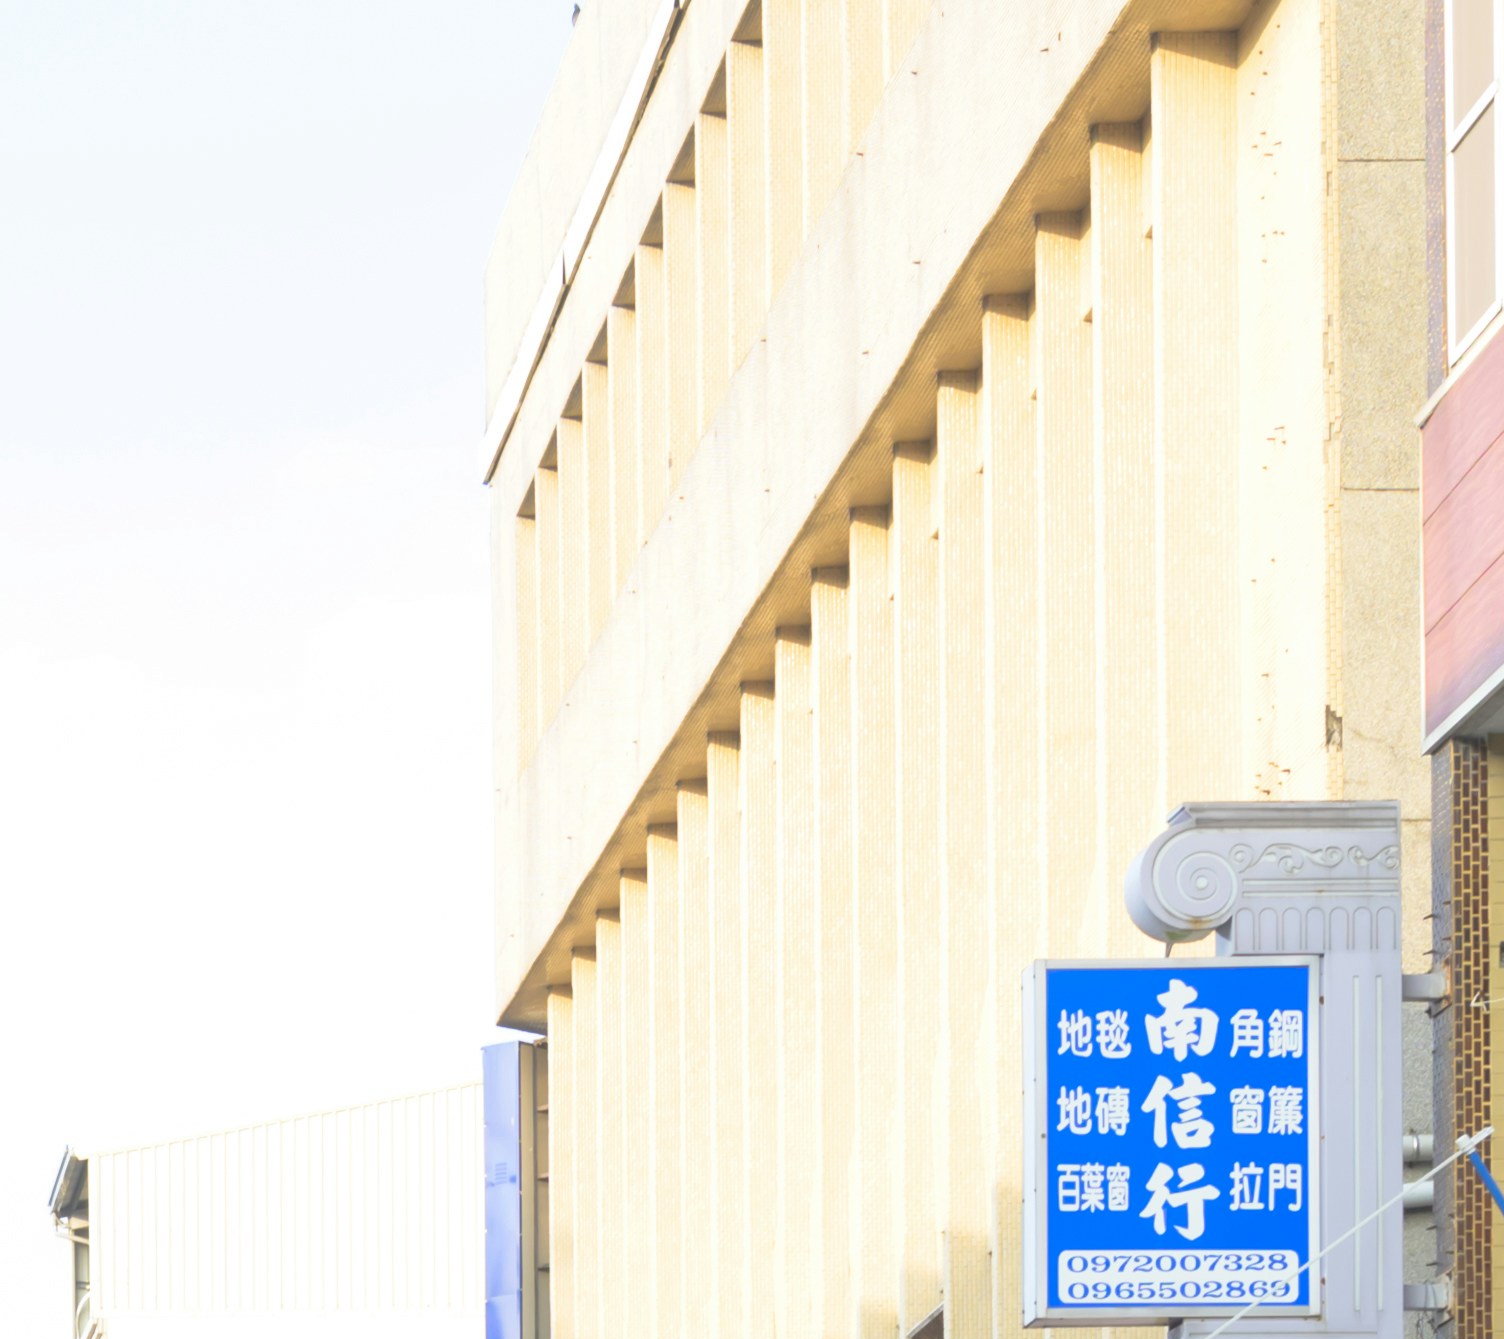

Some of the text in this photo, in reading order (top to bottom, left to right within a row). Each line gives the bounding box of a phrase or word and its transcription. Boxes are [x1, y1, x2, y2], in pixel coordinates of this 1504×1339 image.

[1057, 1009, 1132, 1060] 地毯
[1229, 1008, 1303, 1059] 角鋼
[1057, 1085, 1130, 1136] 地磚
[1139, 978, 1220, 1241] 南信行
[1229, 1085, 1303, 1136] 窗簾
[1057, 1162, 1130, 1213] 百葉窗
[1229, 1161, 1303, 1212] 拉門
[1066, 1252, 1289, 1274] 0972007328
